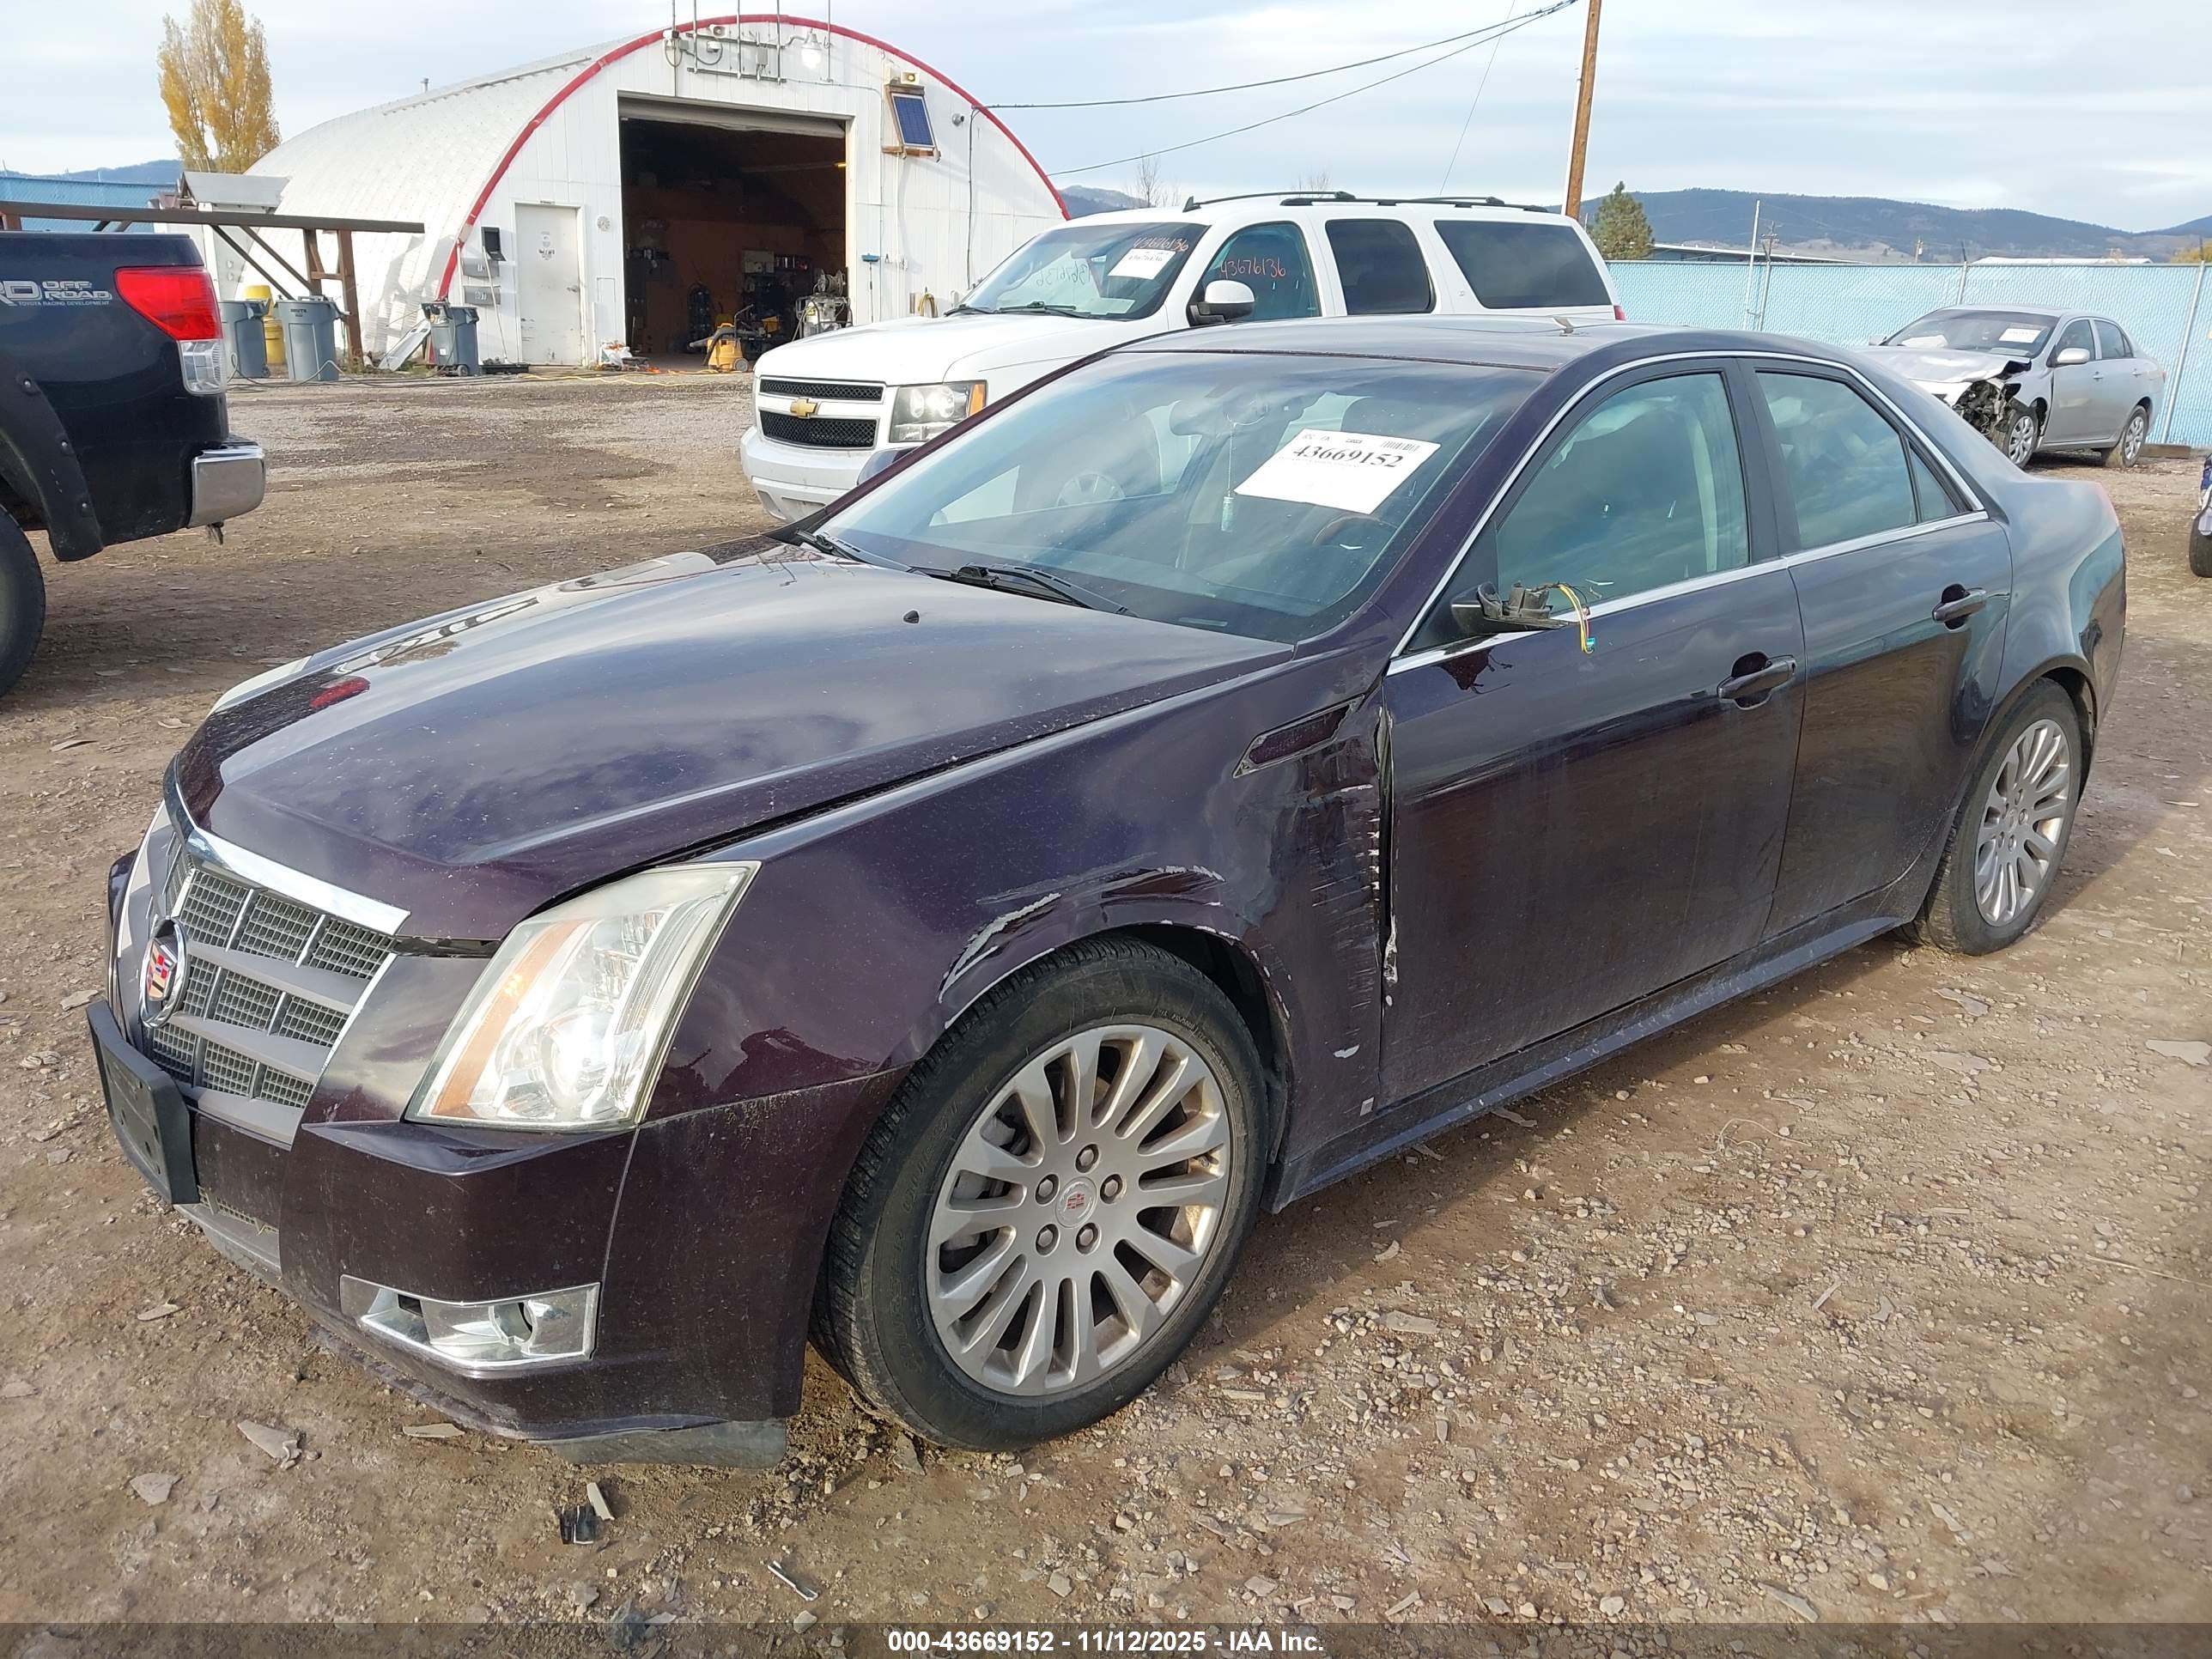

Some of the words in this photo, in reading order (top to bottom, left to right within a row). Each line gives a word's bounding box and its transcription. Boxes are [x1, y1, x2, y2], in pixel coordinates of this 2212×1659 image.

[1220, 256, 1286, 279] 43676136
[42, 281, 93, 291] OFF
[44, 290, 112, 301] ROAD
[1293, 445, 1404, 468] 43669152
